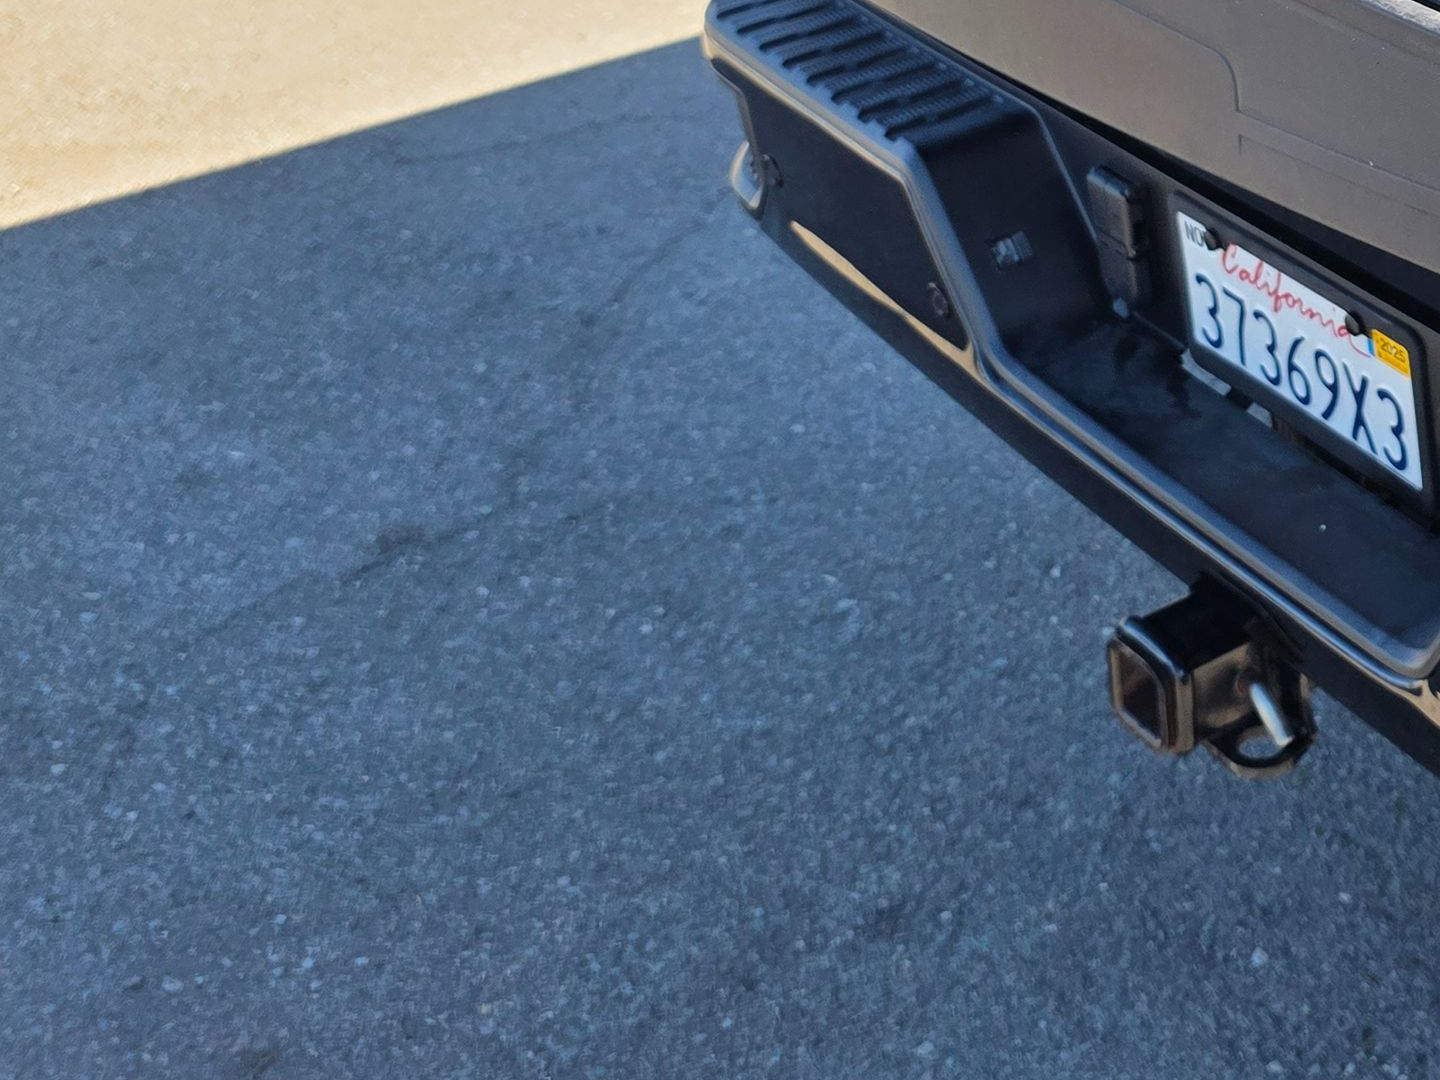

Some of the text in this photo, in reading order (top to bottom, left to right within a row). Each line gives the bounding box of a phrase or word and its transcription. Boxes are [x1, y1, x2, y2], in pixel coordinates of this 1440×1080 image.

[1221, 242, 1374, 358] California
[1380, 341, 1406, 363] 2025
[1195, 274, 1408, 471] 37369X3
